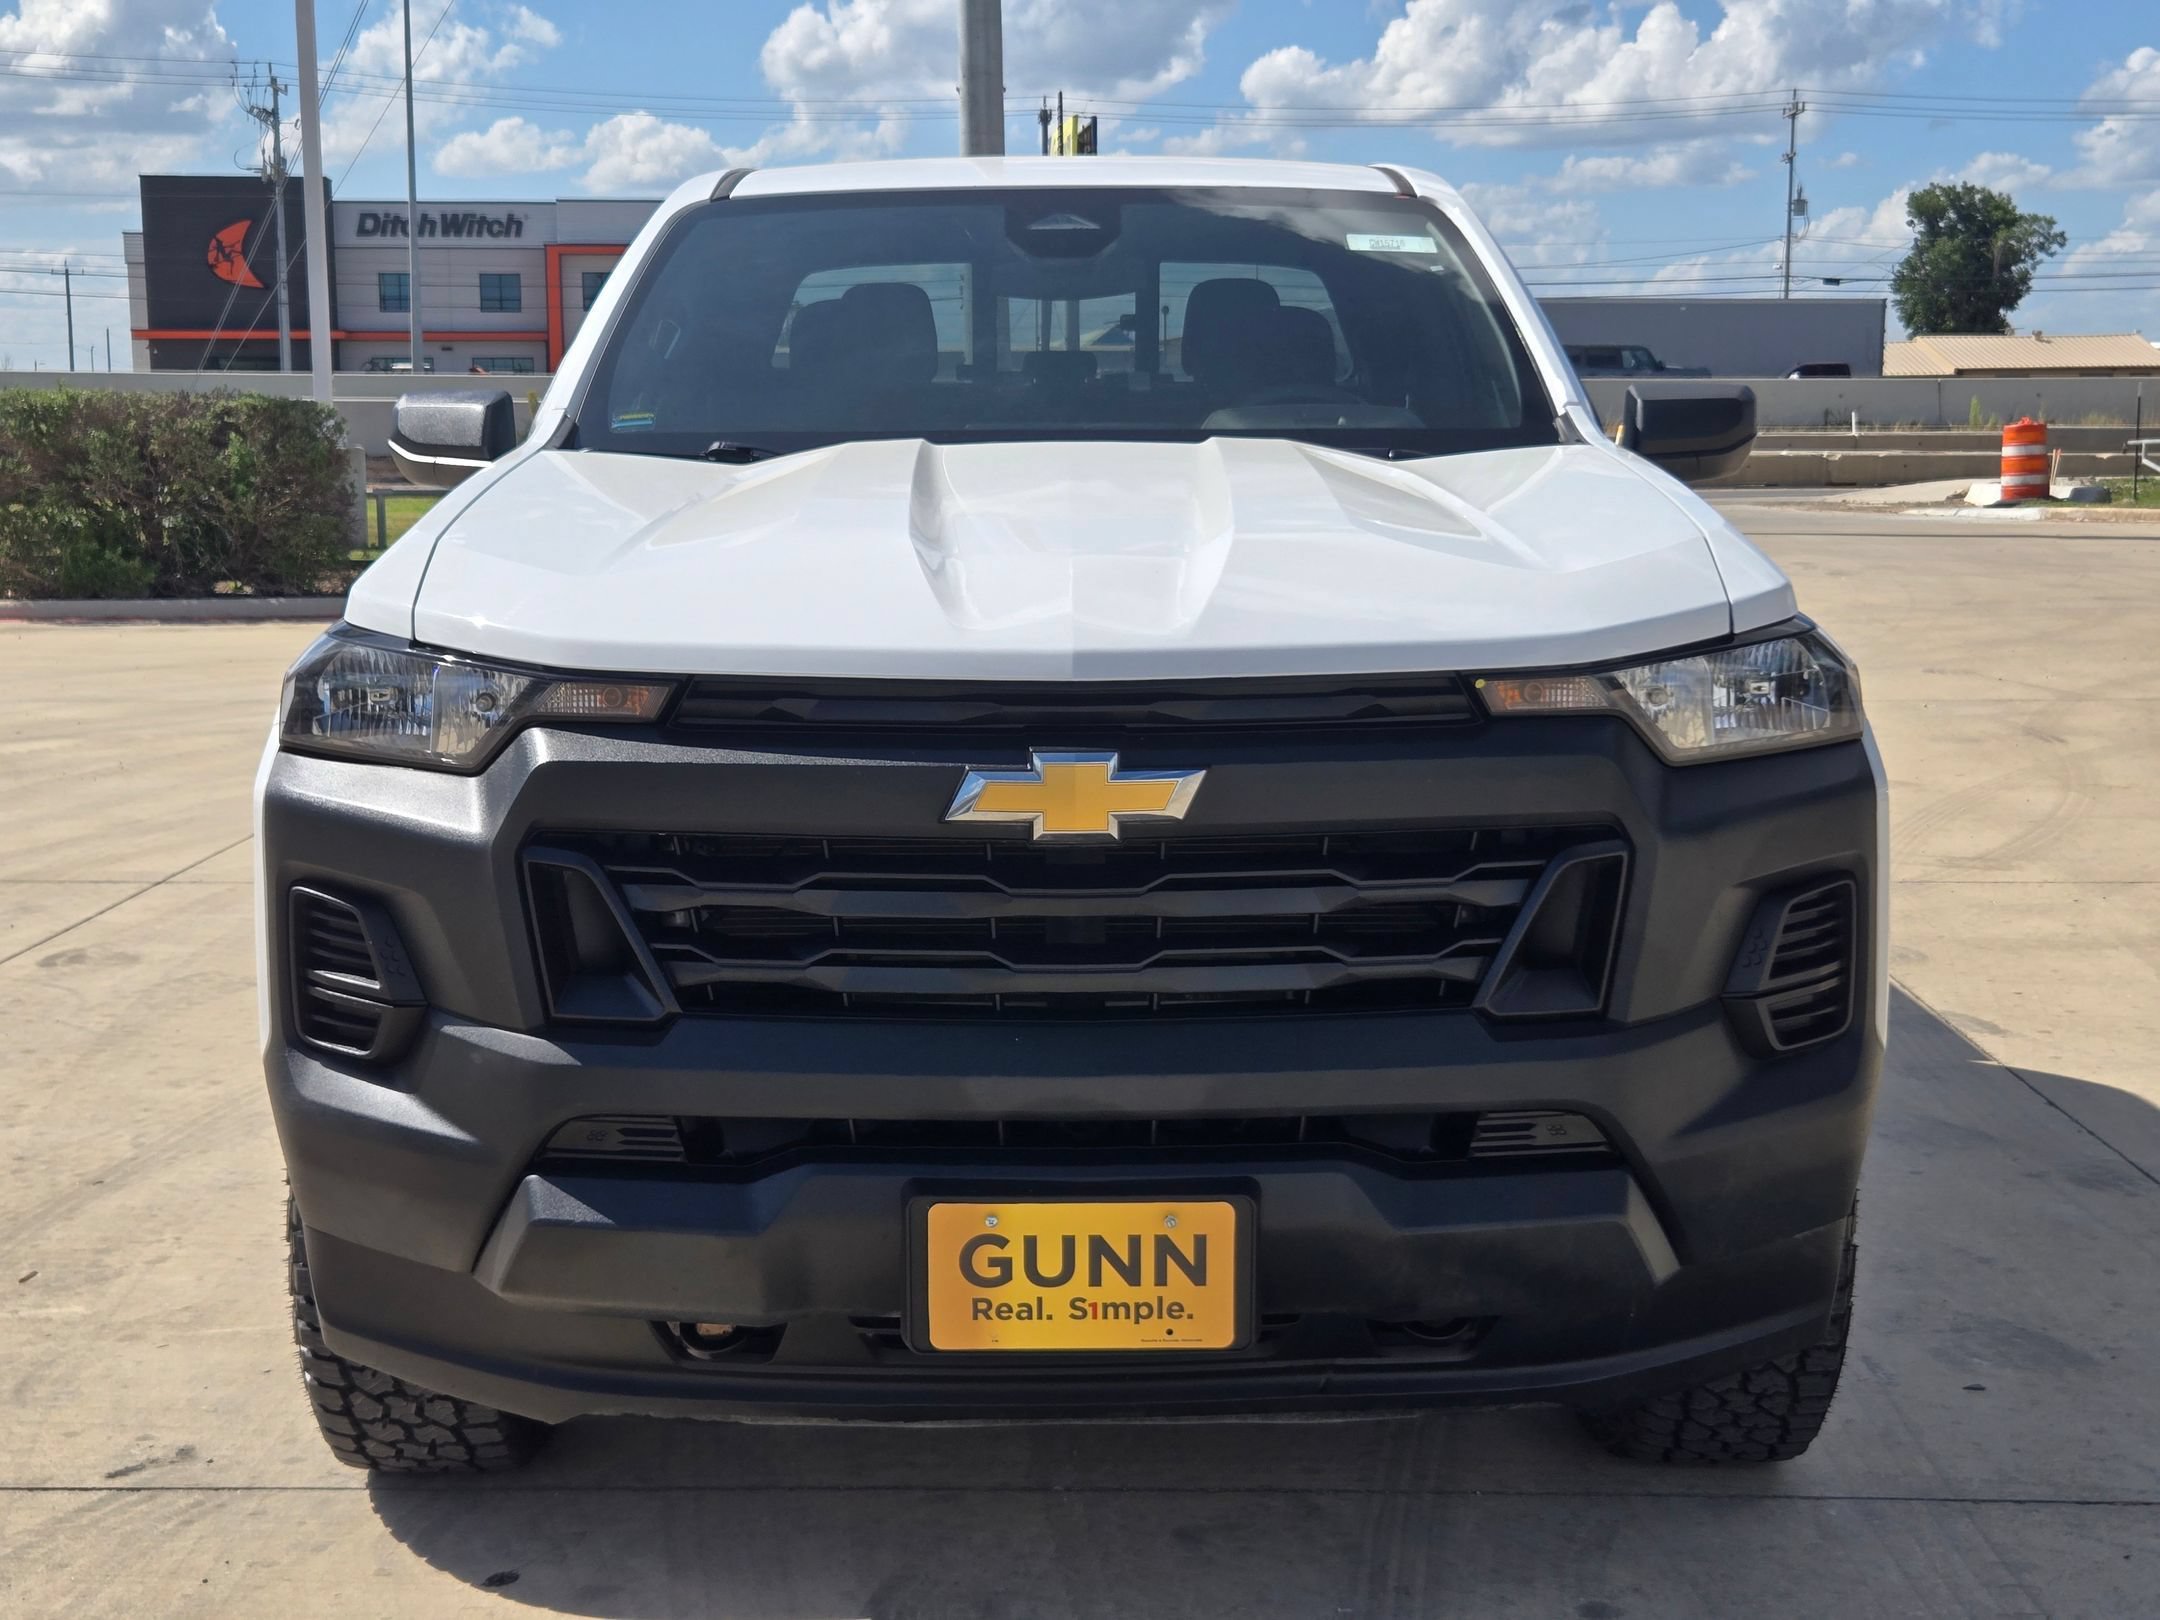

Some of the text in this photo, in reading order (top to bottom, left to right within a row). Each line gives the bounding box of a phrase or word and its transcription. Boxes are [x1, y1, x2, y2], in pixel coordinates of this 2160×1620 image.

[440, 212, 523, 238] Witch
[958, 1233, 1207, 1288] GUNN
[971, 1296, 1194, 1325] Real. S1mple.
